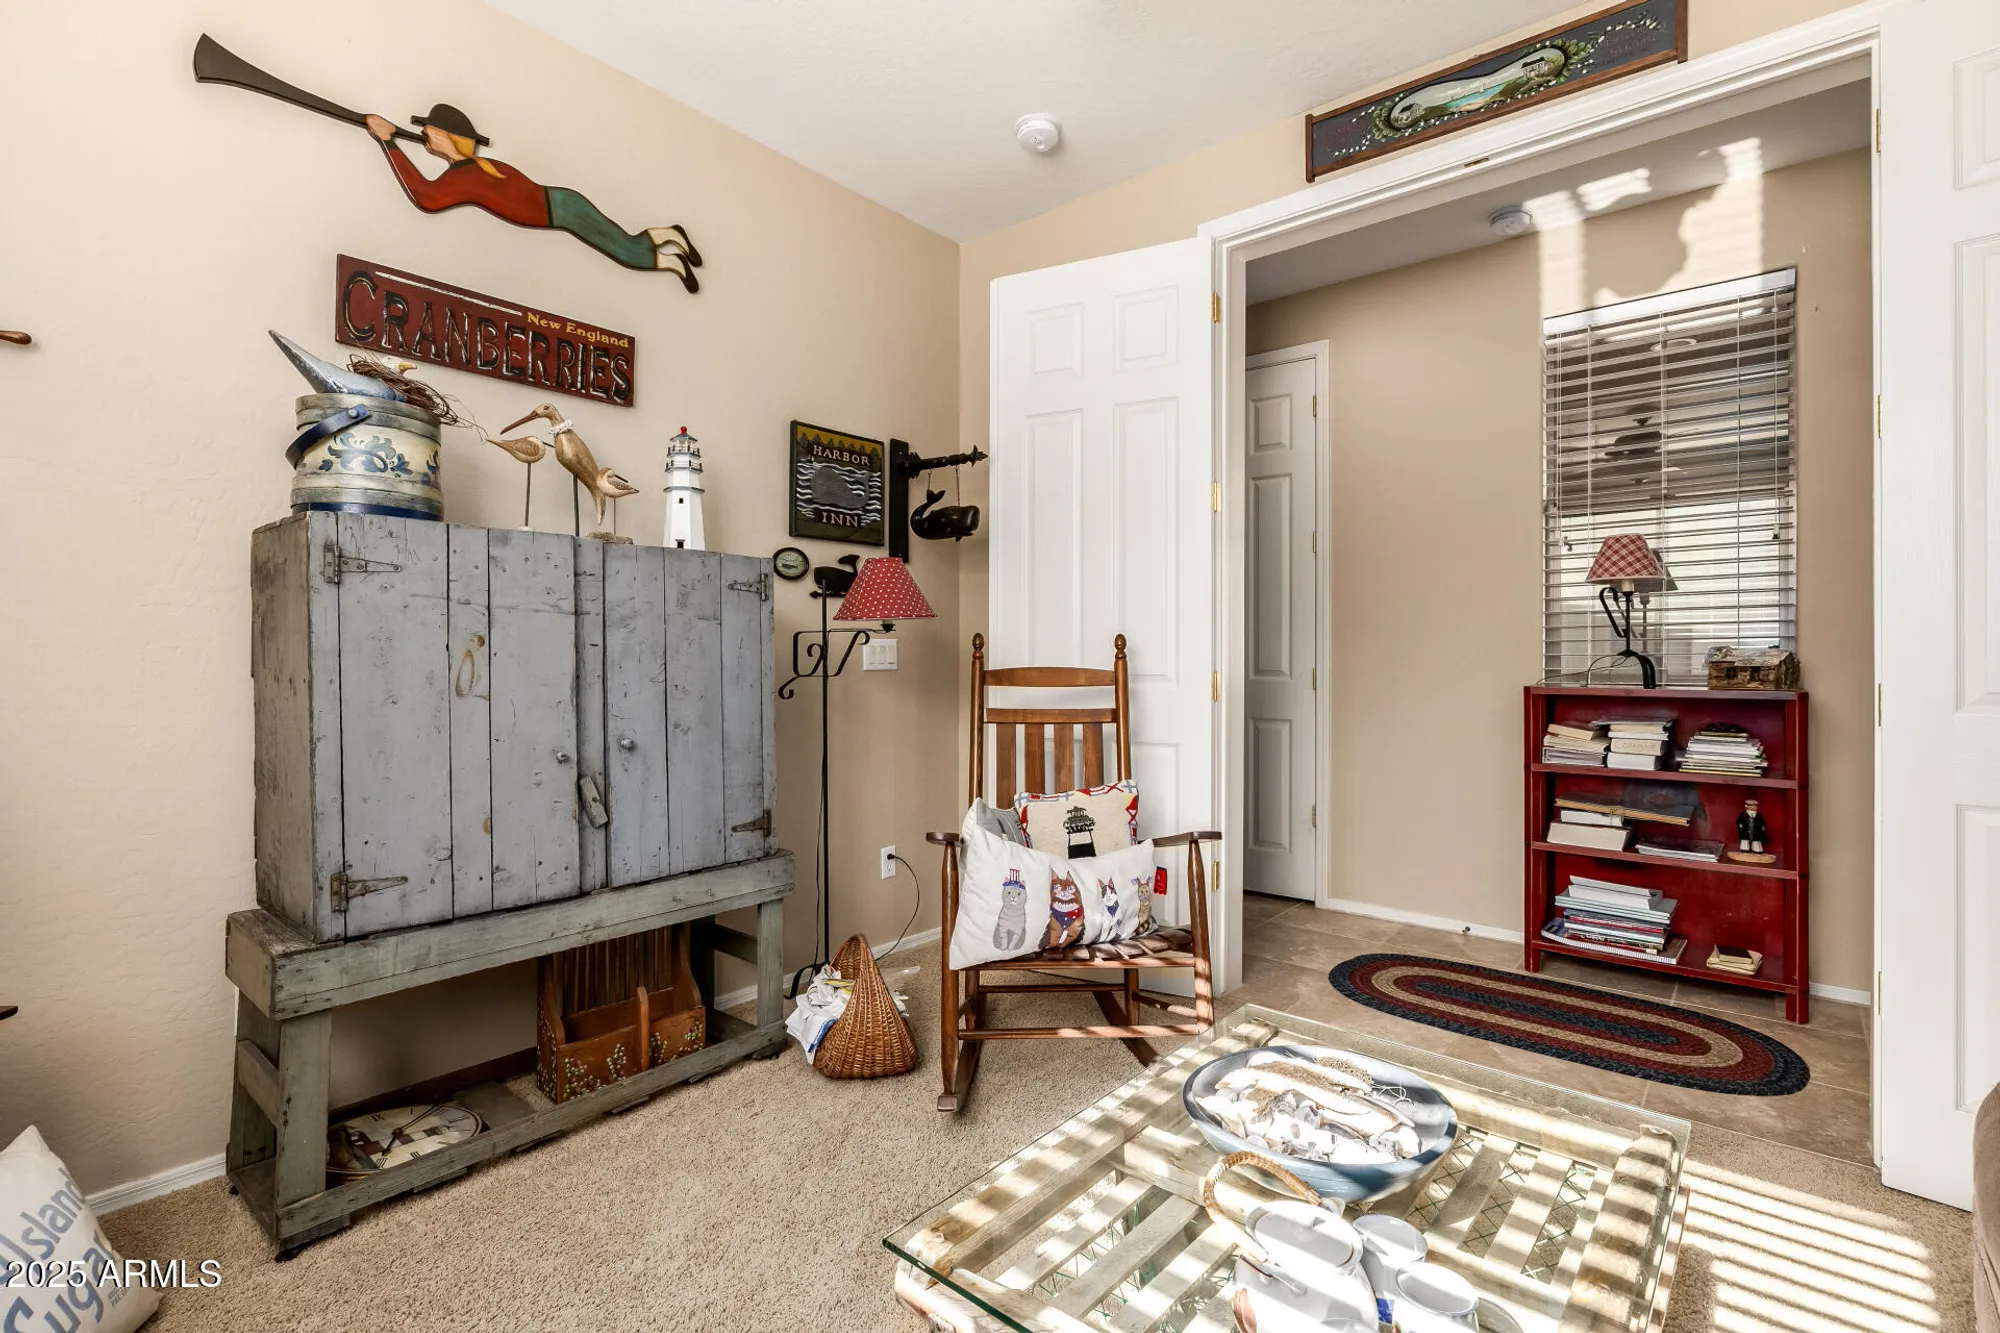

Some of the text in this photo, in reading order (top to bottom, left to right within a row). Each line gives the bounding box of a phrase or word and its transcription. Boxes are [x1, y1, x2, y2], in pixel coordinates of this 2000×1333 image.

[342, 271, 630, 404] CRANBERRIES
[527, 312, 629, 348] New England
[813, 444, 870, 465] HARBOR
[822, 511, 859, 527] INN
